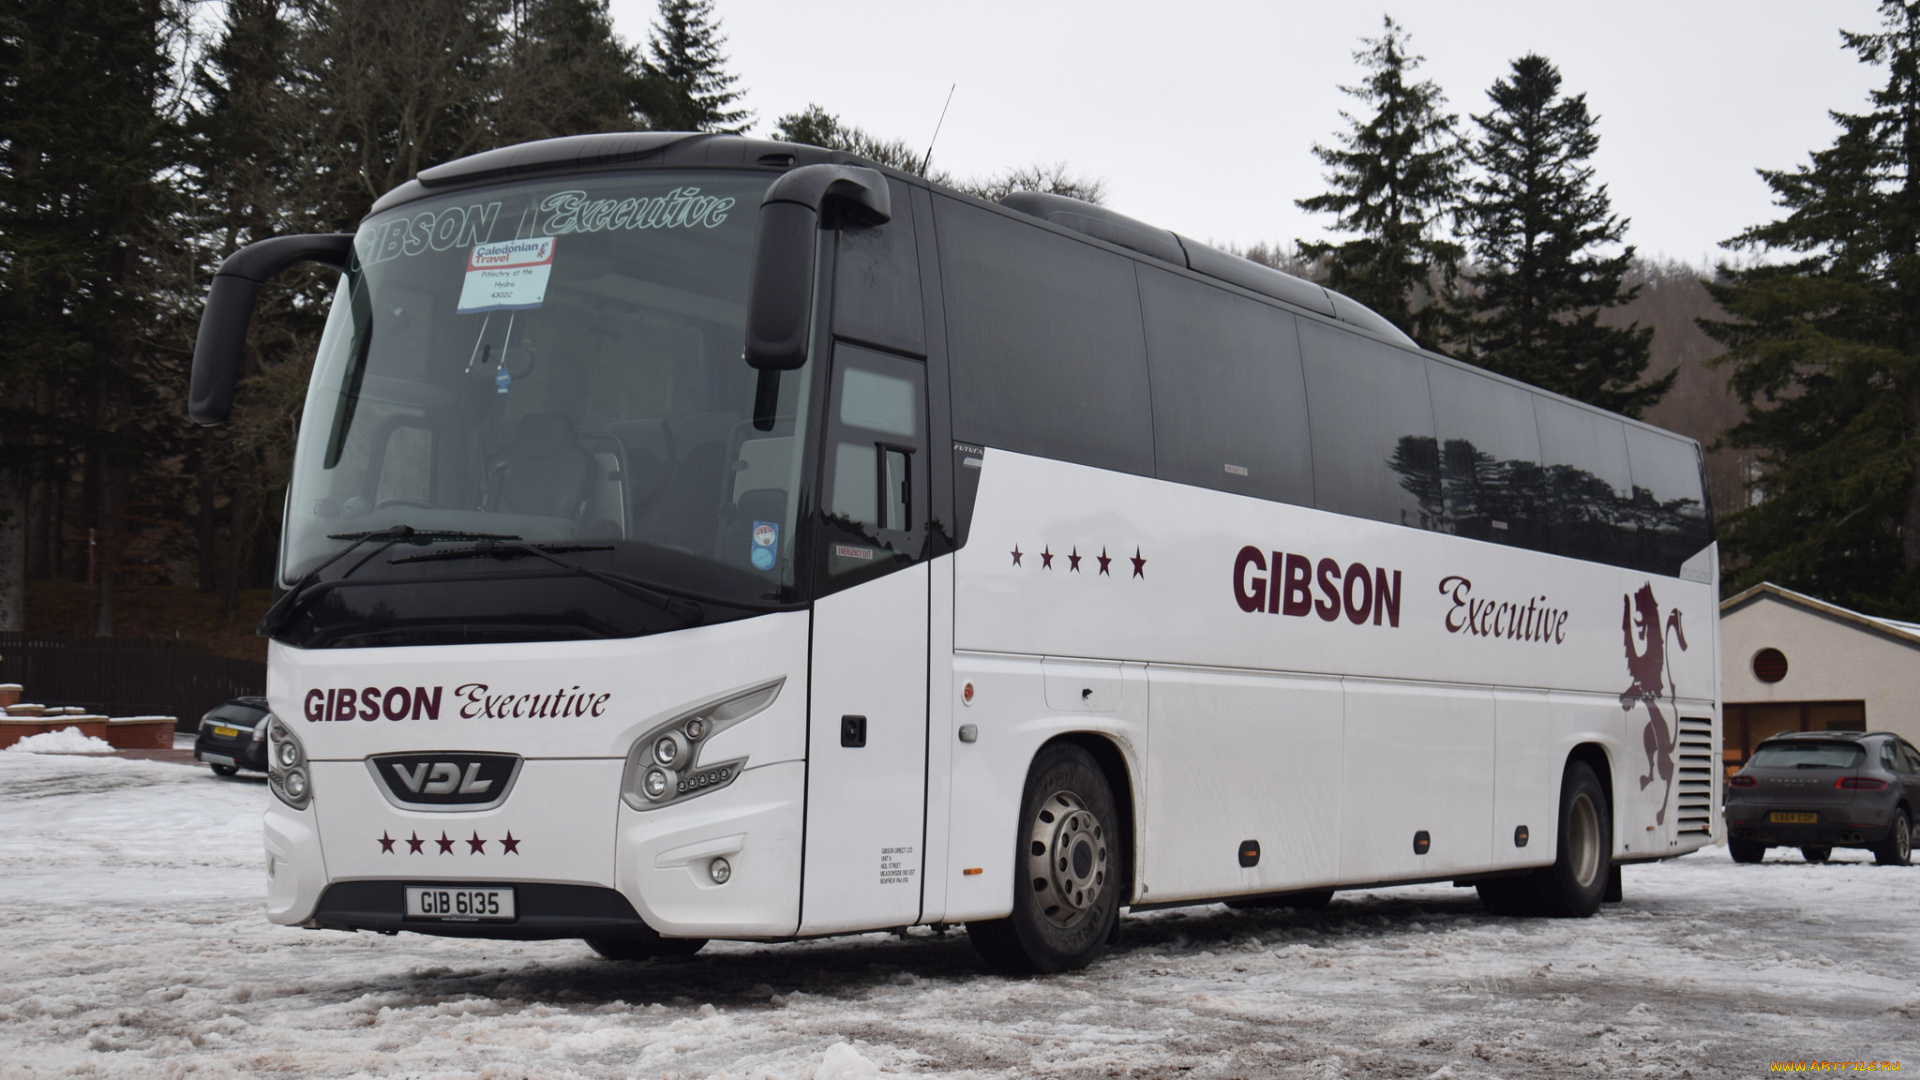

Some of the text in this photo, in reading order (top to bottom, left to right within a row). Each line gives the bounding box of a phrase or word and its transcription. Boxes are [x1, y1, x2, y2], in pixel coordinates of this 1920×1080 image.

[351, 186, 736, 272] GIBSON Executive
[475, 253, 510, 264] Travel
[476, 242, 539, 256] Caledonian
[480, 270, 510, 278] Pitlochry
[494, 280, 516, 289] Hydro
[838, 546, 871, 558] EMERGENCY EXIT
[1233, 545, 1569, 645] GIBSON Executive
[304, 683, 611, 722] GIBSON Executive
[391, 762, 494, 794] VDL
[421, 891, 500, 915] GIB 6135
